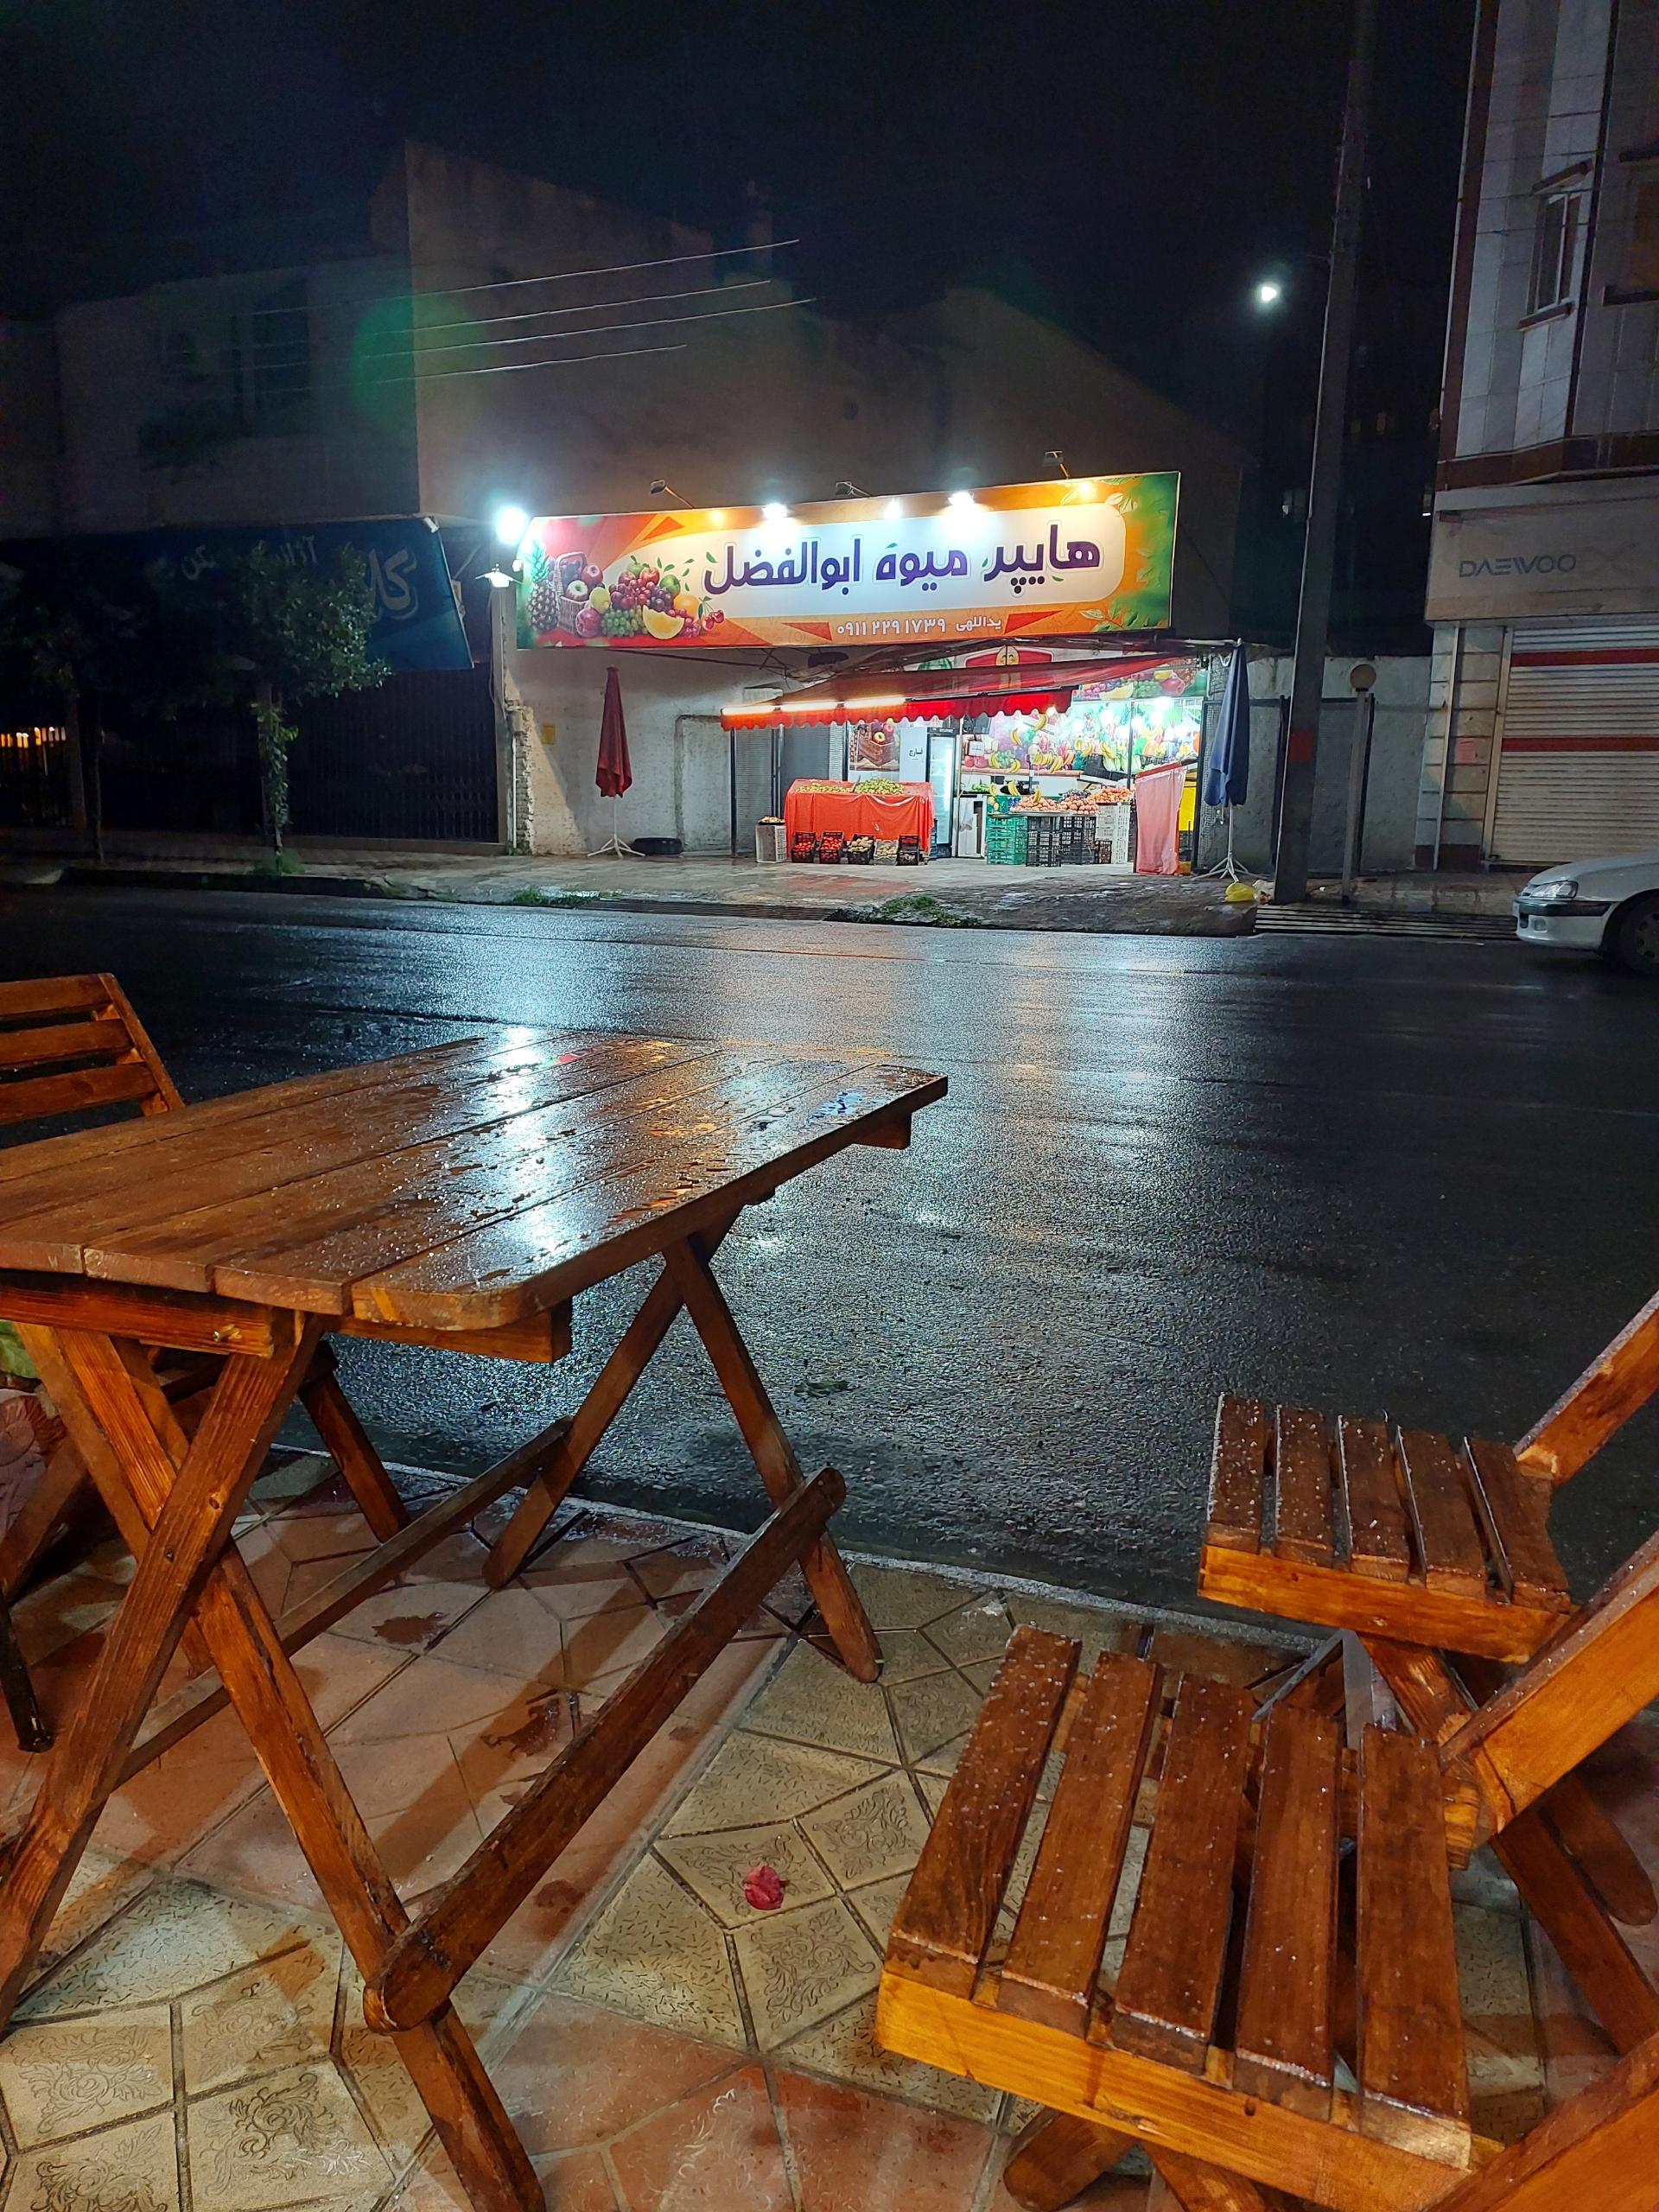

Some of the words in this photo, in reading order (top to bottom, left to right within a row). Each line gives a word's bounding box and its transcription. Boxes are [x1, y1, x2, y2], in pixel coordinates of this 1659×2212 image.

[703, 537, 861, 595] ابوالفضل
[875, 547, 969, 592] میوه
[983, 524, 1101, 594] هایپر
[1459, 553, 1577, 578] DAEWOO
